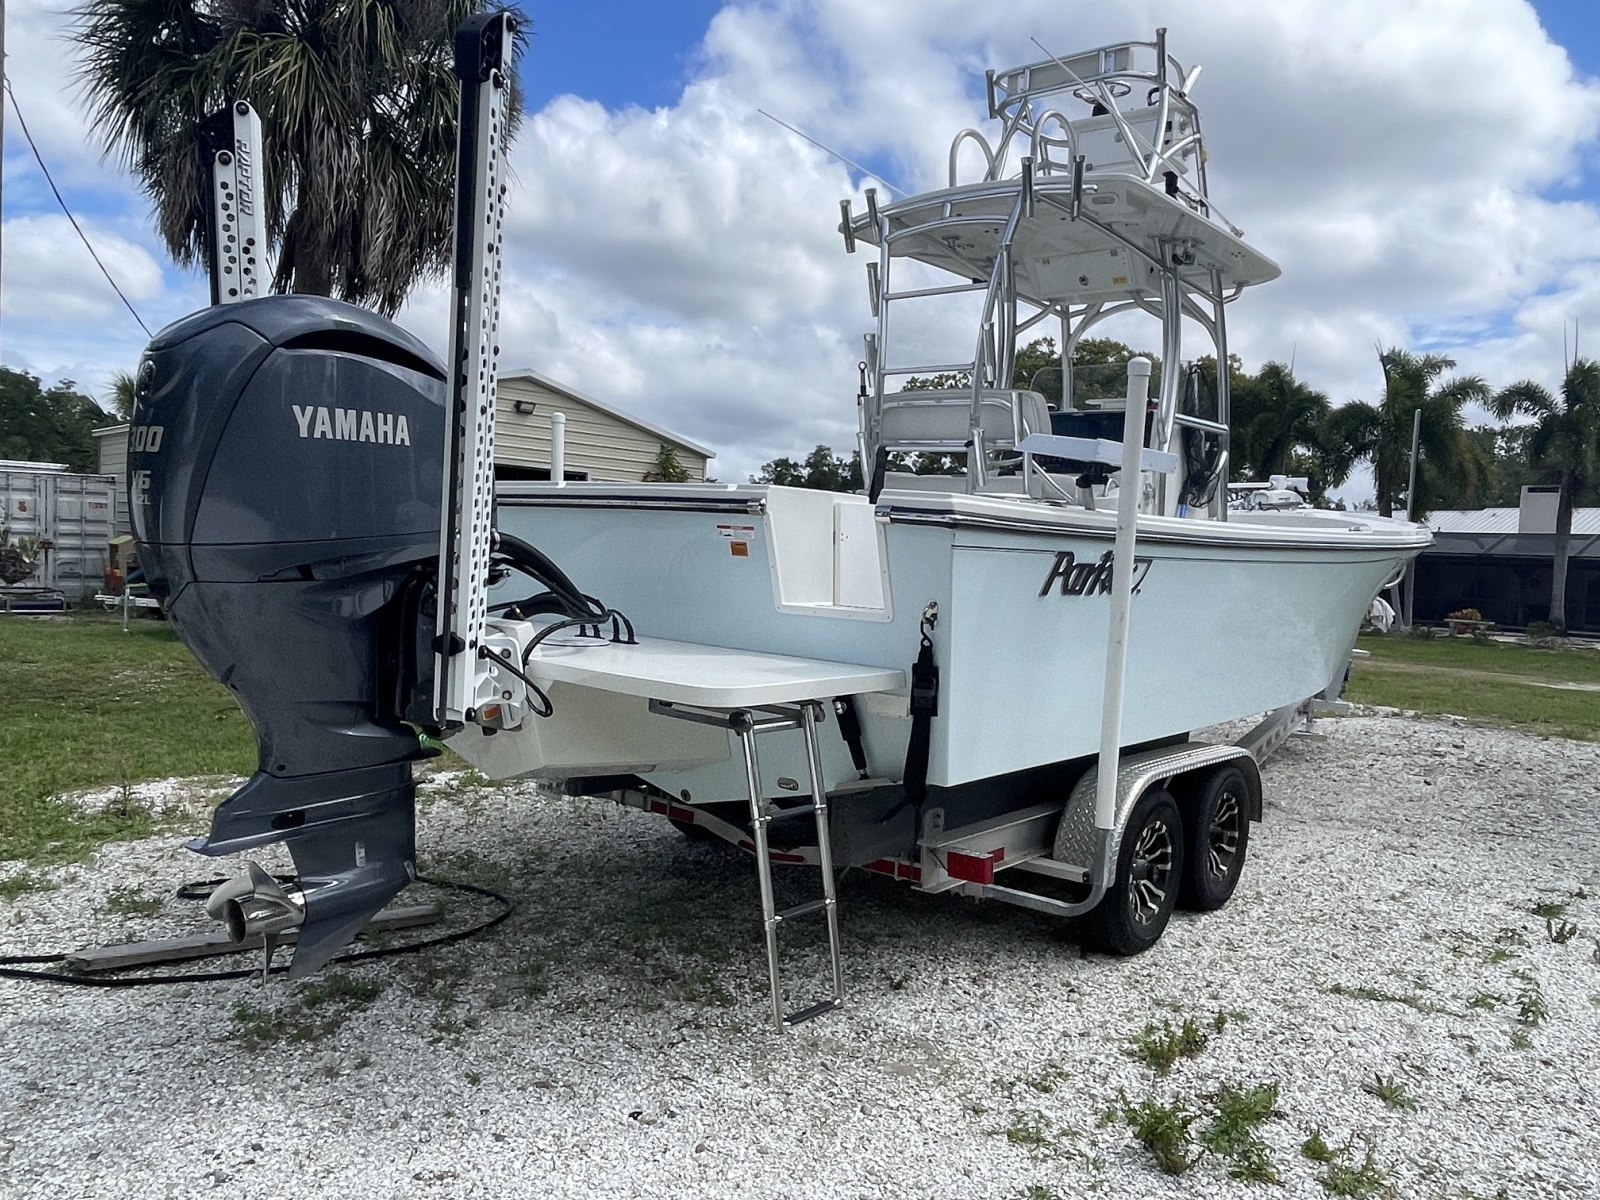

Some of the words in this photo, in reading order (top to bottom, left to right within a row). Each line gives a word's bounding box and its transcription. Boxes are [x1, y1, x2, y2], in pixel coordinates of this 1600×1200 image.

[236, 138, 254, 217] RAPTOR
[291, 404, 411, 447] YAMAHA
[1038, 549, 1140, 598] Park
